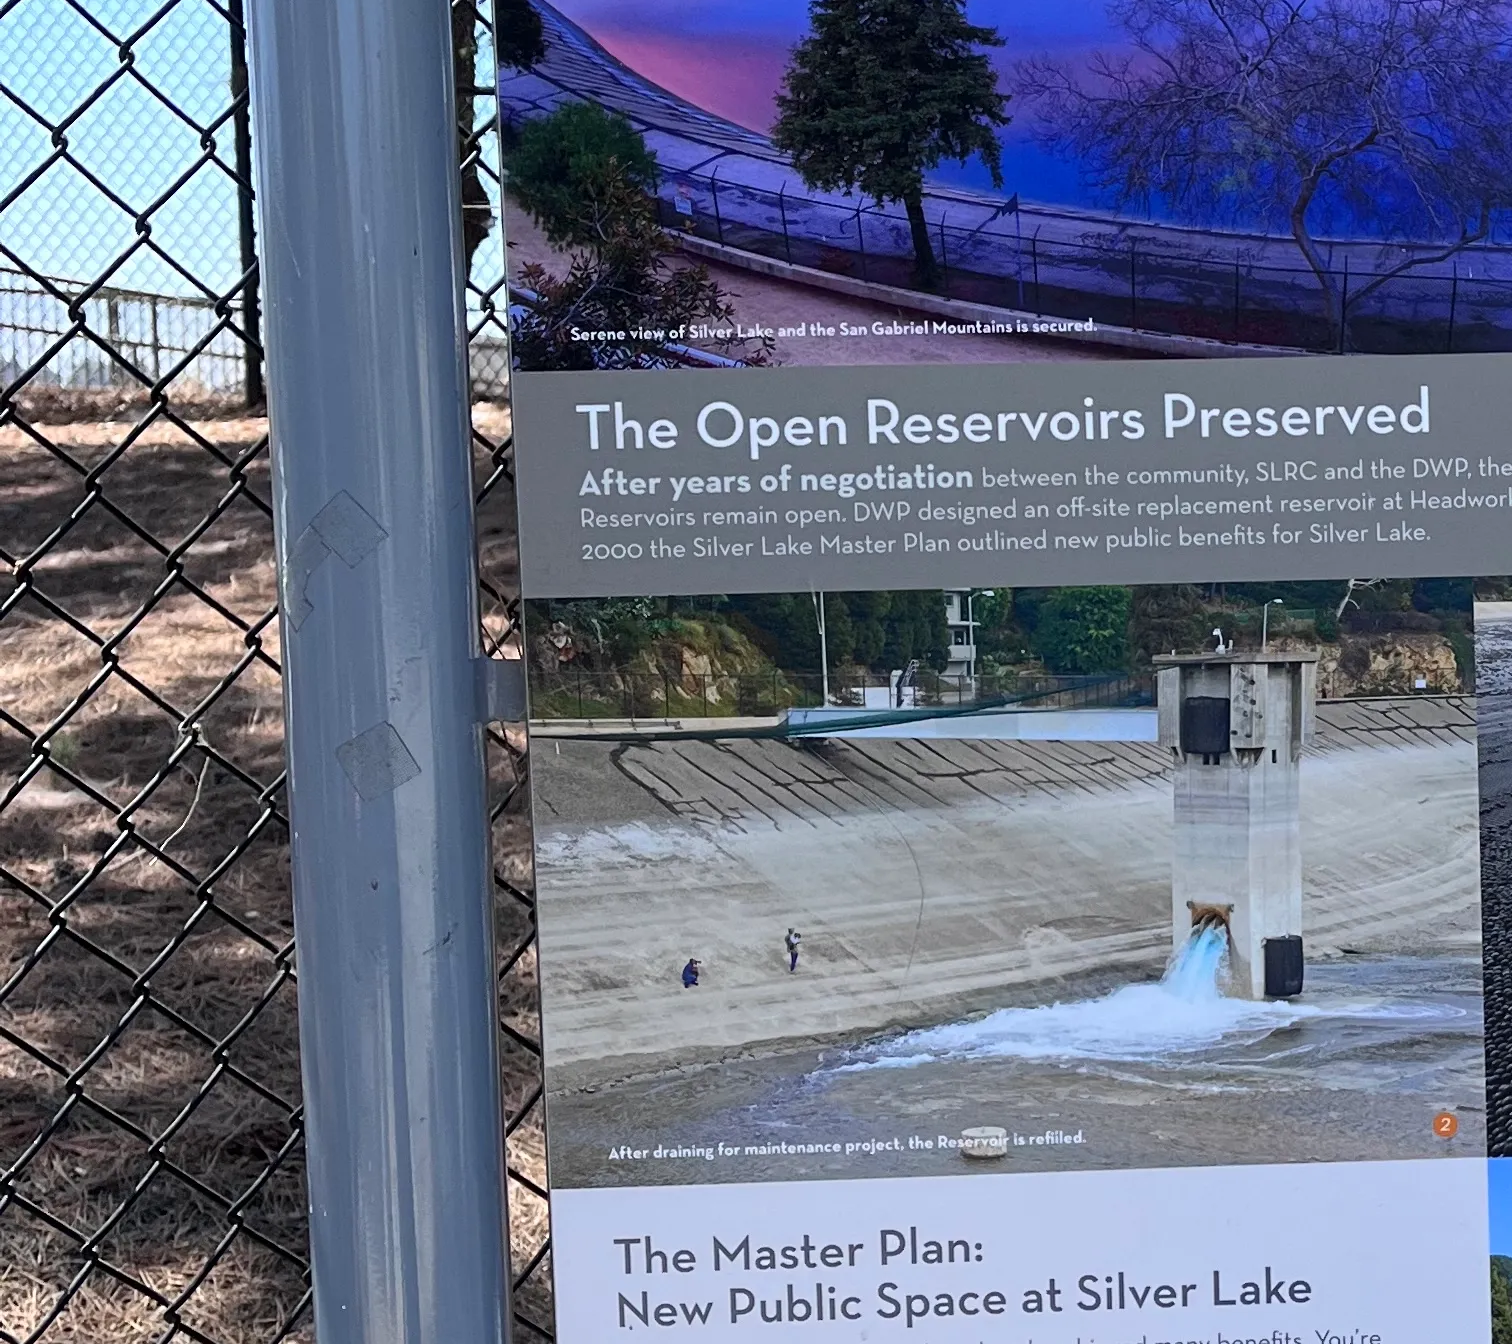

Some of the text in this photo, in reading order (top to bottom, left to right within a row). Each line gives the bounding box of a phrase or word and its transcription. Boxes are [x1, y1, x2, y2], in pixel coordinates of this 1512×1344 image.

[570, 318, 1098, 341] Serene view of Silver Lake and the San Gabriel Mountains is secured.
[575, 385, 1430, 460] The Open Reservoirs Preserved
[1440, 1117, 1452, 1132] 2
[608, 1144, 650, 1160] After
[652, 1143, 715, 1161] draining
[717, 1142, 741, 1157] for
[744, 1141, 841, 1156] maintenance
[845, 1136, 905, 1155] project,
[908, 1135, 934, 1150] the
[937, 1133, 1010, 1150] Reservoir
[1012, 1132, 1026, 1147] is
[612, 1226, 983, 1275] The Master Plan:
[618, 1265, 1313, 1328] New Public Space at Silver Lake
